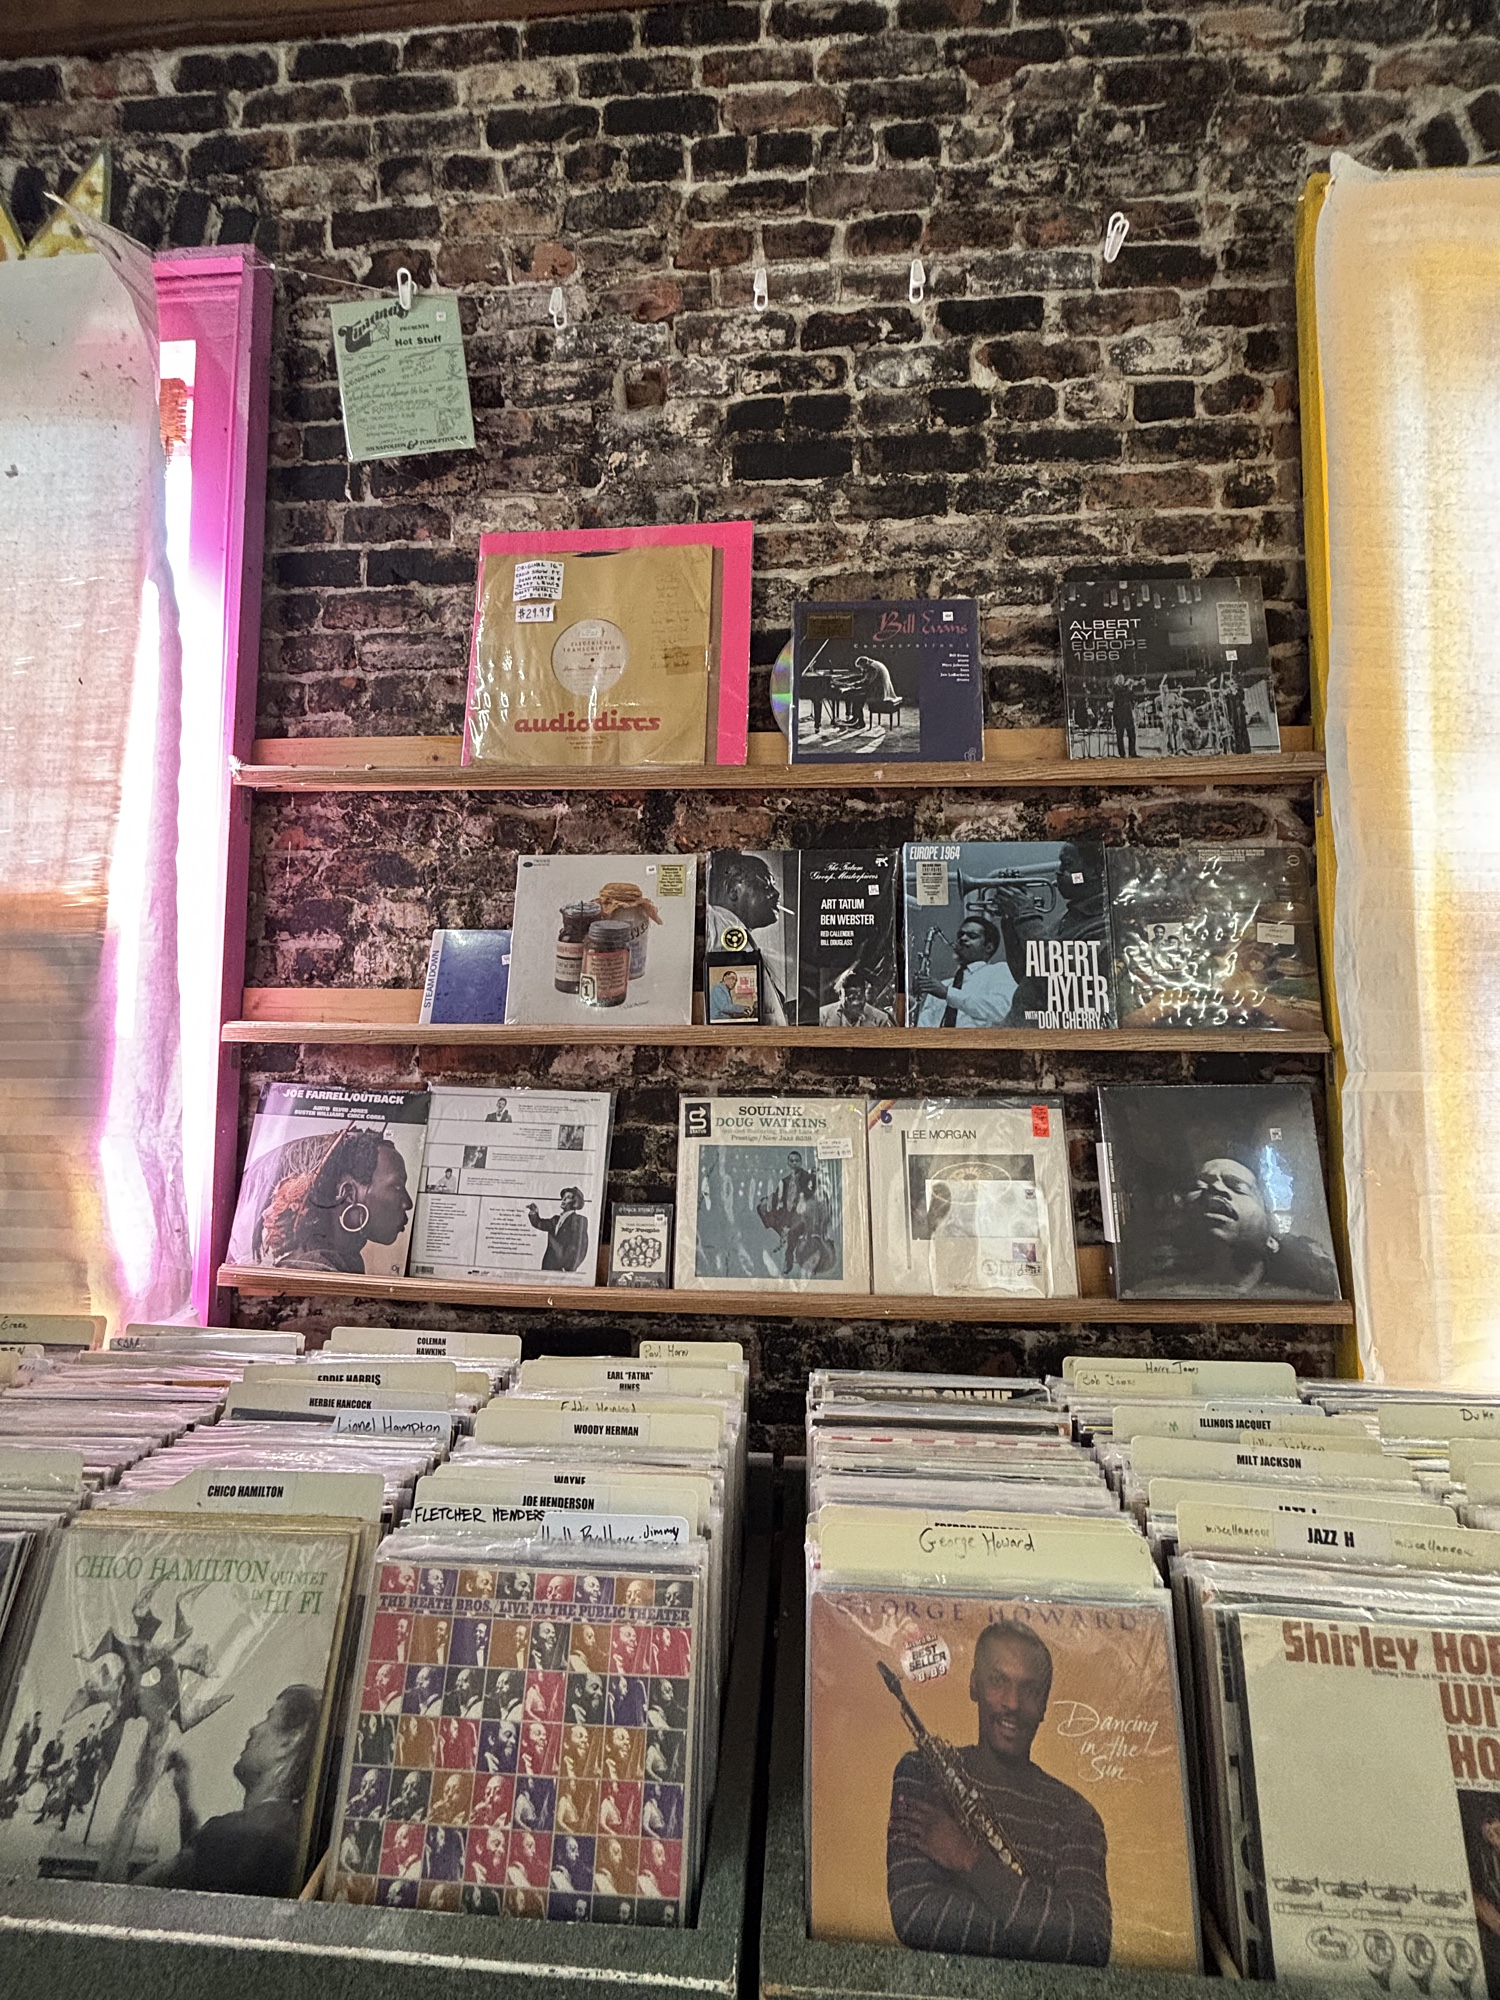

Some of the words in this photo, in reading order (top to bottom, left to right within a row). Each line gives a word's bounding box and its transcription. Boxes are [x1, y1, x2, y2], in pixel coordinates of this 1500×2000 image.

[395, 338, 412, 347] Hot
[417, 335, 442, 345] Stuff
[873, 611, 915, 641] Bill
[922, 609, 969, 634] Evans
[1069, 618, 1141, 631] ALBERT
[1070, 630, 1128, 641] AYLER
[1071, 639, 1147, 651] EUROPE
[1074, 651, 1120, 661] 1966
[910, 846, 939, 860] EUROPE
[940, 846, 961, 860] 1964
[820, 899, 837, 909] ART
[838, 899, 865, 909] TATUM
[820, 914, 836, 925] BEN
[837, 914, 875, 925] WEBSTER
[1025, 940, 1100, 977] ALBERT
[423, 978, 435, 1008] STEAM
[429, 950, 440, 977] DOWN
[1047, 976, 1109, 1012] AYLER
[1025, 1010, 1038, 1020] WITH
[1038, 1011, 1059, 1030] DON
[1062, 1011, 1101, 1030] CHERRY
[283, 1089, 303, 1099] JOE
[739, 1105, 803, 1116] SOULNIK
[716, 1117, 754, 1127] DOUG
[759, 1118, 828, 1128] WATKINS
[906, 1130, 926, 1139] LEE
[929, 1130, 977, 1140] MORGAN
[417, 1337, 446, 1346] COLEMAN
[416, 1347, 447, 1356] HAWKINS
[607, 1371, 624, 1380] EARL
[309, 1398, 335, 1408] HERBIE
[336, 1399, 372, 1409] HANCOCK
[337, 1416, 376, 1433] Lionel
[382, 1415, 441, 1435] Hampton
[574, 1424, 604, 1435] WOODY
[605, 1425, 639, 1436] HERMAN
[1200, 1418, 1234, 1428] ILLINOIS
[1235, 1419, 1271, 1430] JACQUET
[1237, 1454, 1258, 1466] MILT
[1260, 1456, 1301, 1468] JACKSON
[207, 1484, 236, 1498] CHICO
[237, 1485, 284, 1498] HAMILTON
[522, 1495, 539, 1507] JOE
[540, 1496, 595, 1510] HENDERSON
[414, 1506, 487, 1523] FLETCHER
[493, 1507, 545, 1522] HENDERS
[919, 1528, 975, 1558] George
[982, 1531, 1036, 1555] Howard
[1308, 1527, 1339, 1546] JAZZ
[1344, 1530, 1356, 1548] H
[74, 1555, 143, 1580] CHICO
[150, 1557, 270, 1583] HAMILTON
[270, 1570, 328, 1586] QUINTET
[380, 1595, 406, 1607] THE
[409, 1596, 453, 1609] HEATH
[500, 1600, 530, 1614] LIVE
[531, 1603, 548, 1614] AT
[550, 1604, 576, 1616] THE
[578, 1604, 626, 1618] PUBLIC
[628, 1606, 690, 1621] THEATER
[988, 1605, 1137, 1630] HOWARD
[912, 1644, 937, 1660] BEST
[1282, 1620, 1418, 1671] Shirley
[909, 1652, 947, 1672] SELLER
[1438, 1682, 1500, 1728] WI
[1053, 1700, 1174, 1756] Dancing
[1080, 1740, 1098, 1756] in
[1100, 1735, 1140, 1761] the
[1078, 1755, 1138, 1783] Sun
